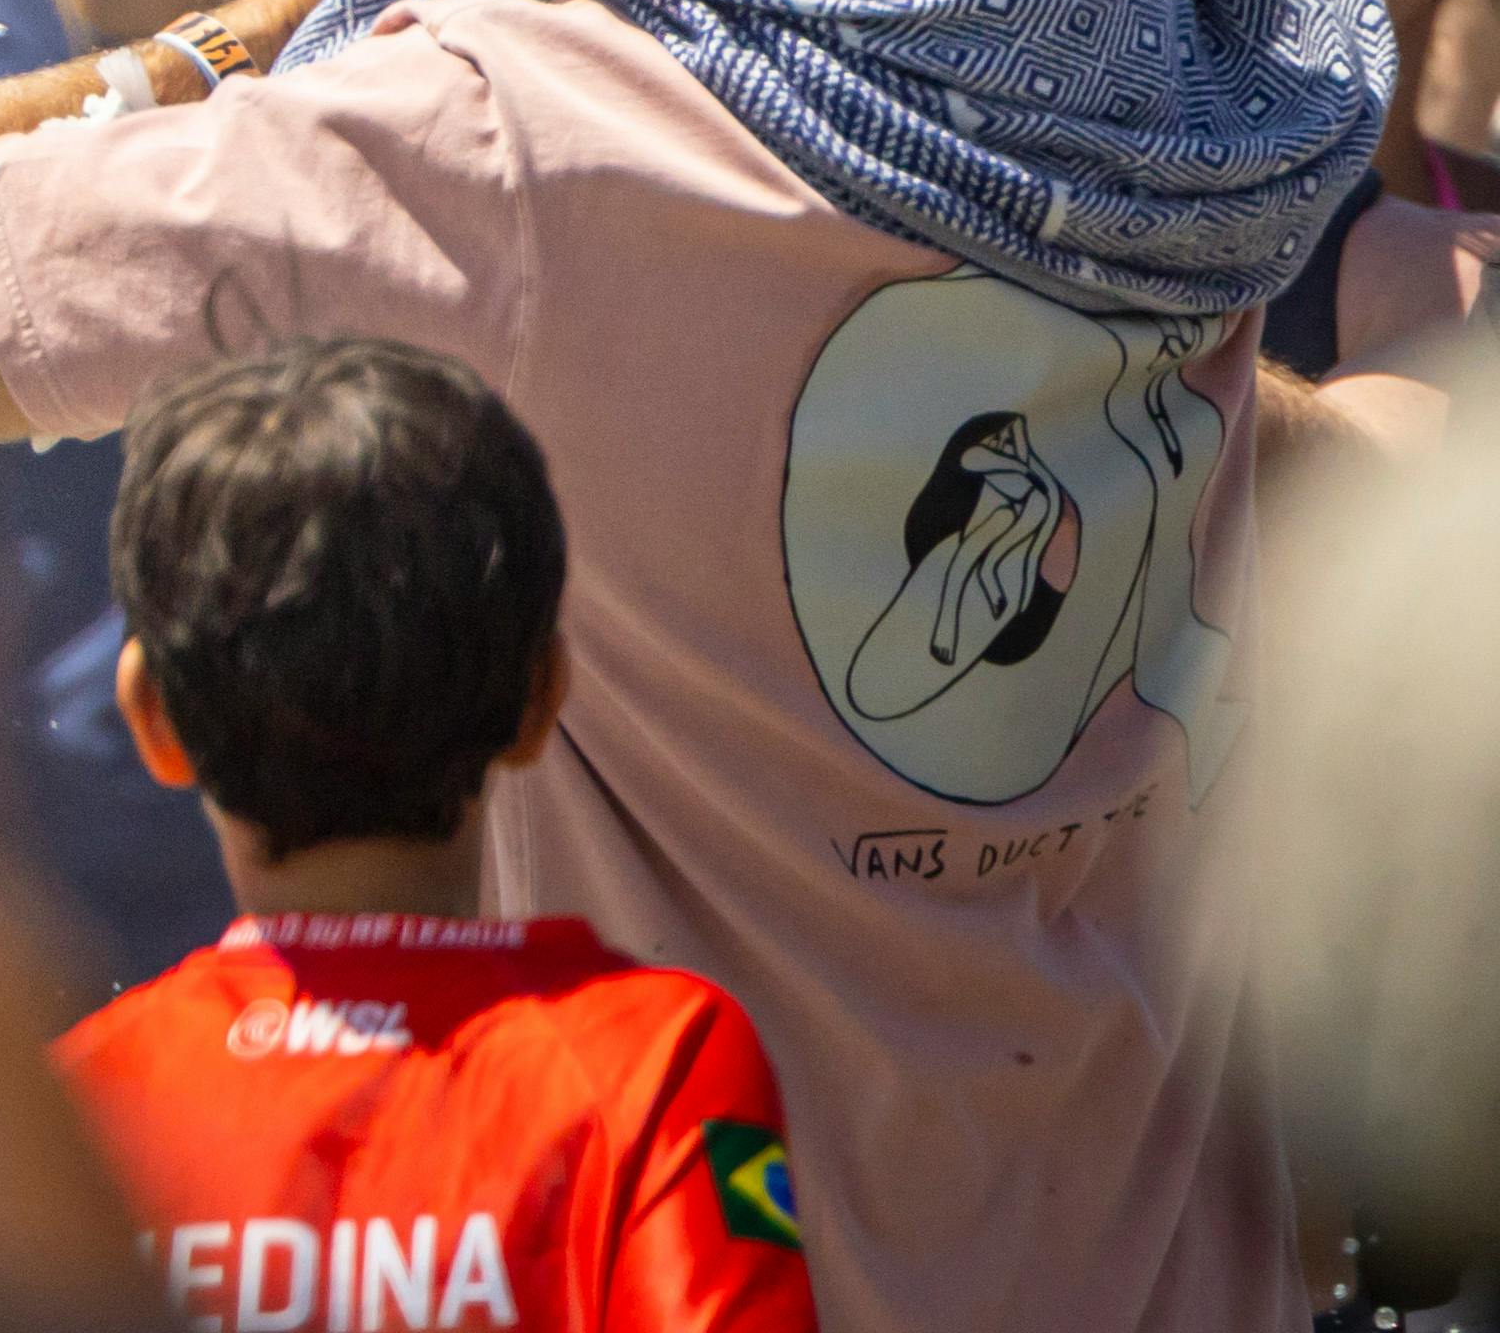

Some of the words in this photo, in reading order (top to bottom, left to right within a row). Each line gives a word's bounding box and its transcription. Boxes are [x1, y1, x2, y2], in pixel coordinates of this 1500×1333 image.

[830, 828, 949, 880] VANS
[976, 823, 1082, 878] DUCT
[136, 1211, 522, 1333] EDINA
